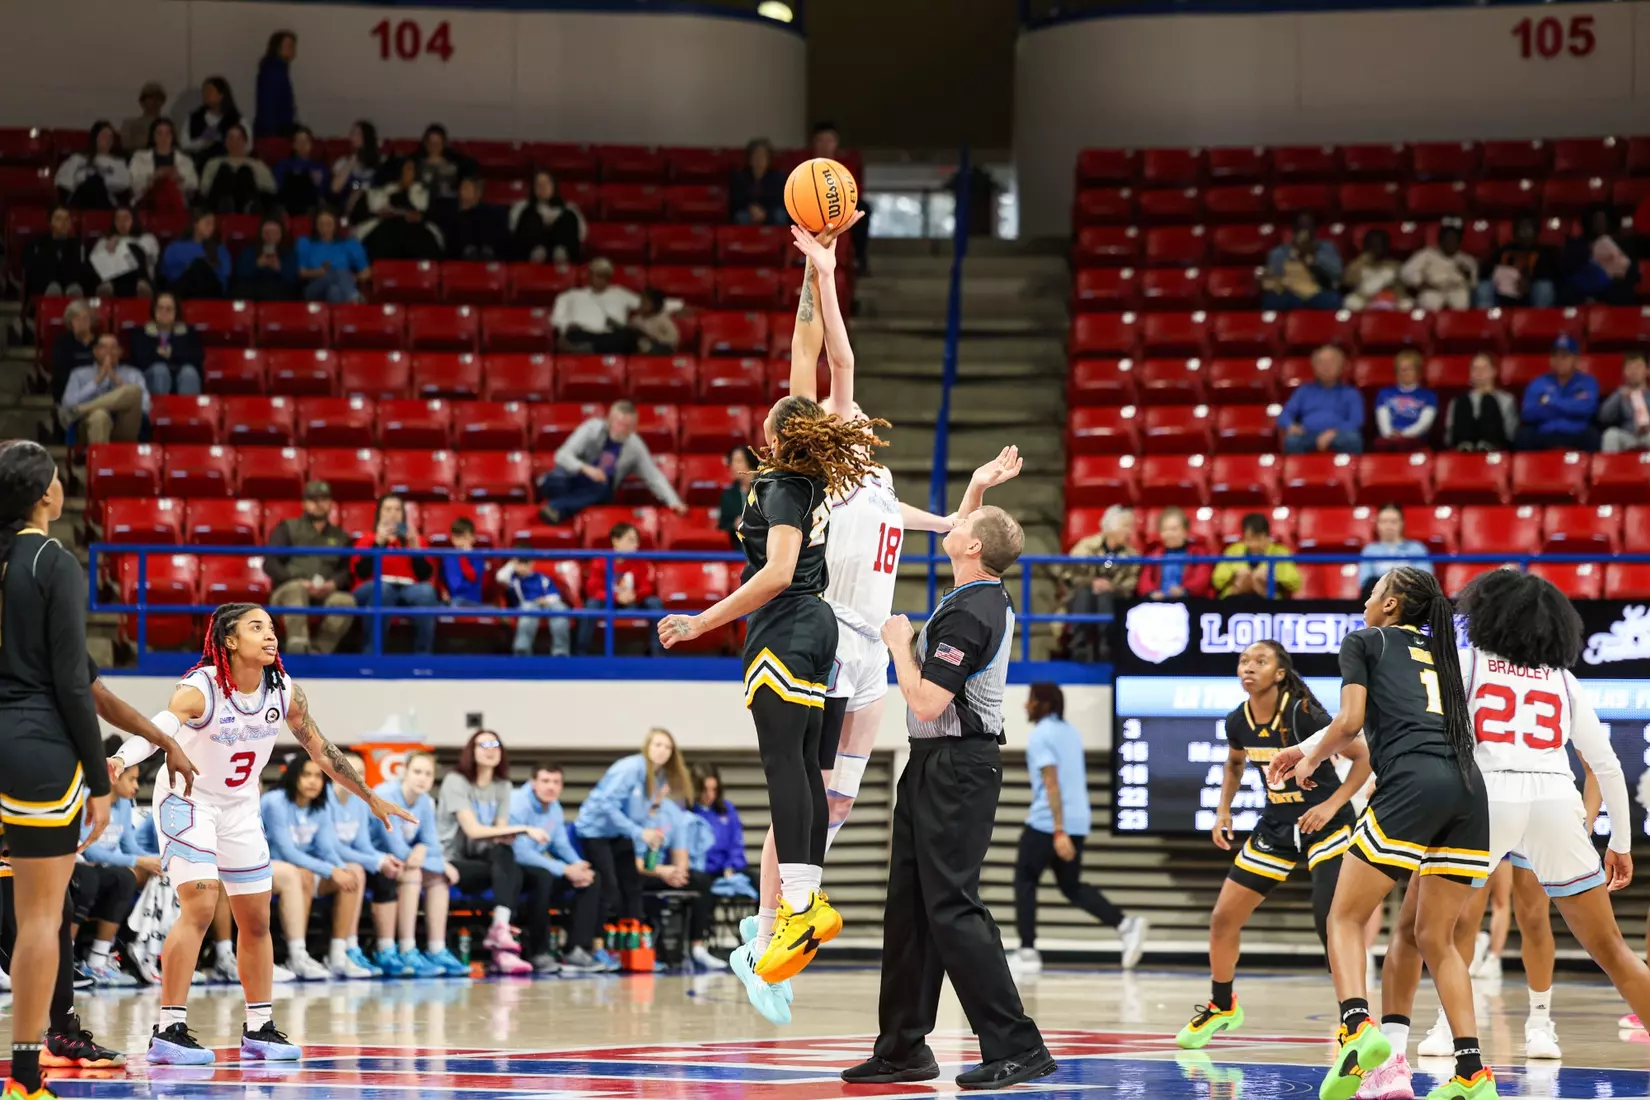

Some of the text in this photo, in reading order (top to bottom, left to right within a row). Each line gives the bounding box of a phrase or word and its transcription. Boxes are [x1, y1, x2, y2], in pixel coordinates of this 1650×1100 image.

[371, 19, 455, 63] 104
[1512, 15, 1596, 59] 105
[822, 168, 841, 220] Wilson
[873, 522, 902, 574] 18
[1419, 667, 1445, 716] 1
[1488, 659, 1551, 681] BRADLEY
[1474, 682, 1563, 750] 23
[224, 750, 257, 788] 3
